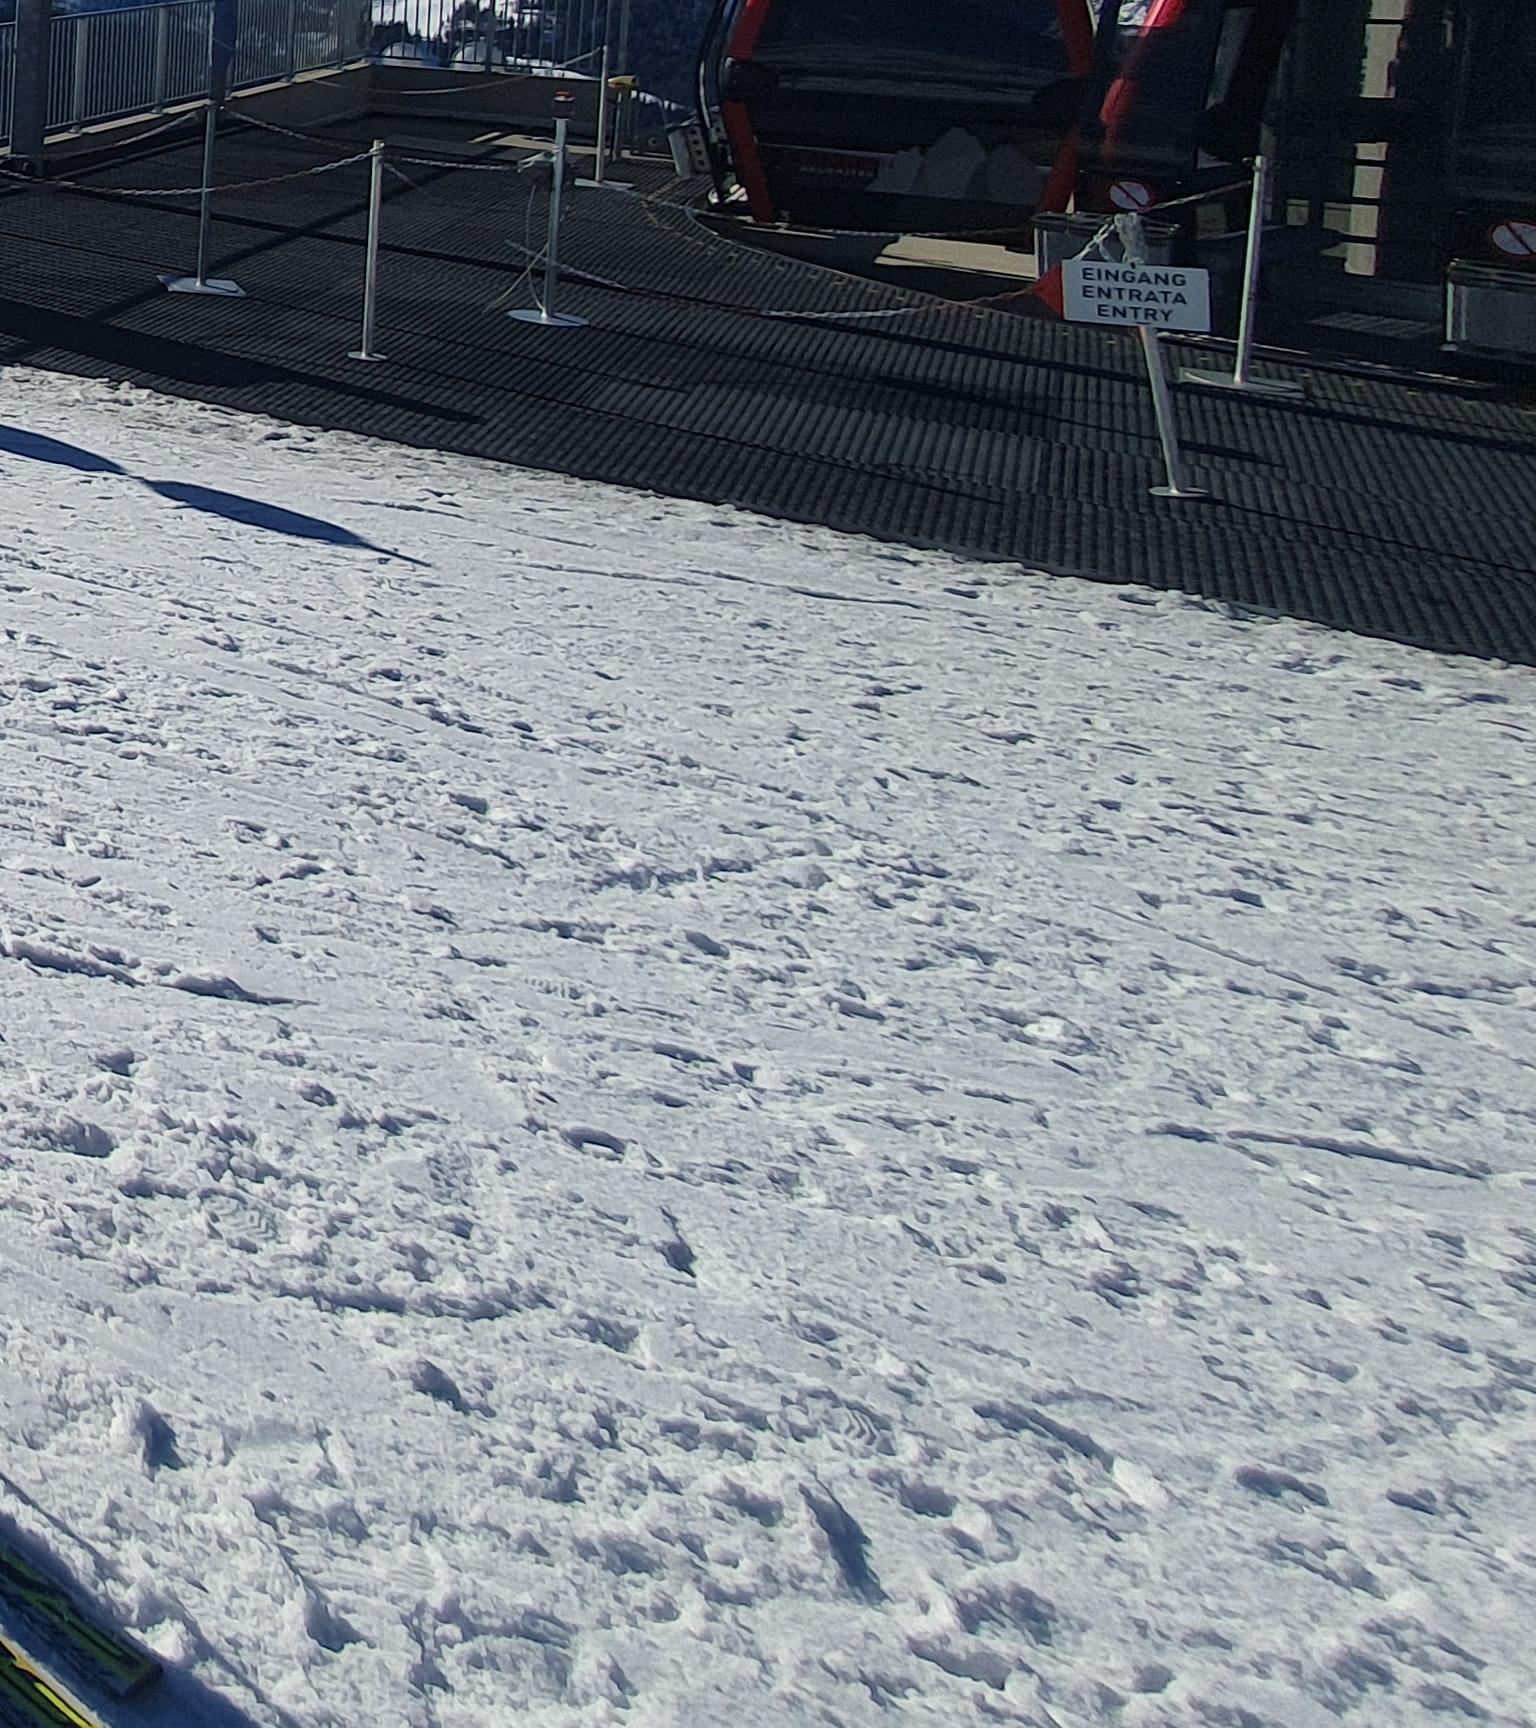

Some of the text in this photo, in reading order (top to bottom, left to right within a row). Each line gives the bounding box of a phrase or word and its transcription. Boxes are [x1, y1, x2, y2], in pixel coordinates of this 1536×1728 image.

[1082, 267, 1187, 287] EINGANG
[1082, 285, 1188, 305] ENTRATA
[1097, 304, 1174, 322] ENTRY
